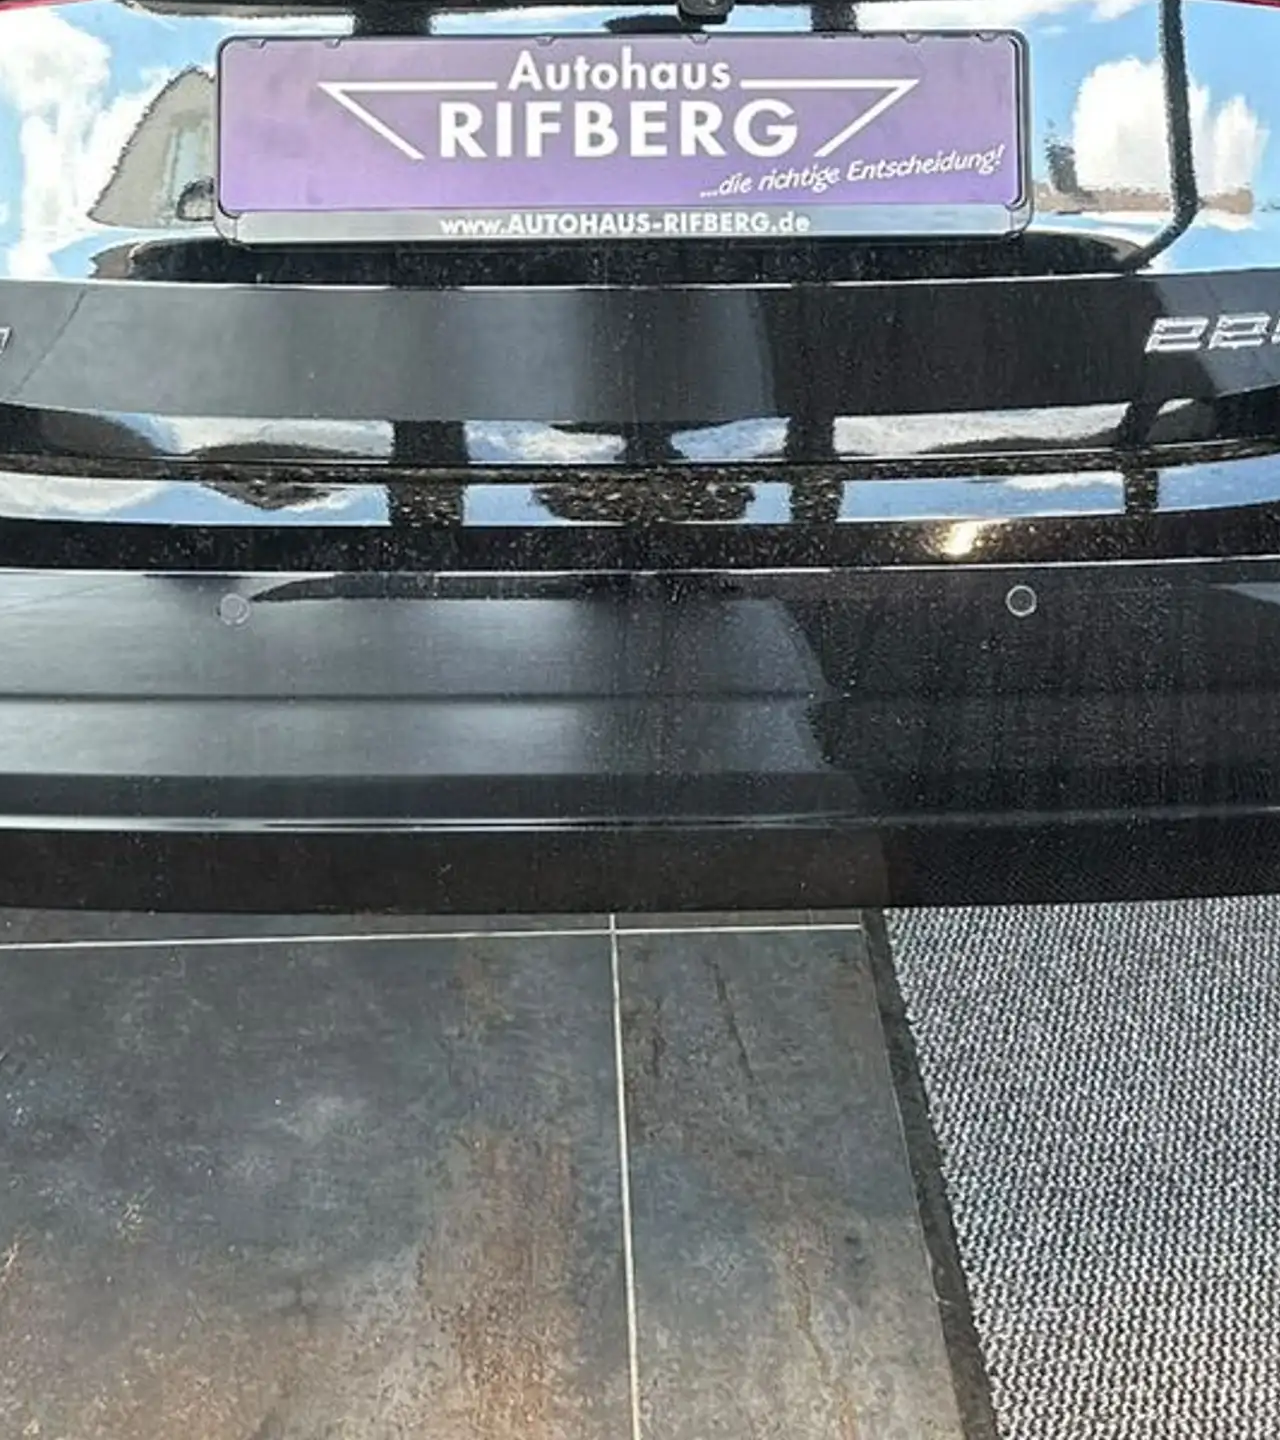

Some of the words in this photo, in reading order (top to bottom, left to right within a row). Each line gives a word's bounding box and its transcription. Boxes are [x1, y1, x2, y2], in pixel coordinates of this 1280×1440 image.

[508, 46, 732, 91] Autohaus
[438, 98, 799, 158] RIFBERG
[758, 165, 841, 192] richtige
[846, 145, 1006, 183] Entscheidung!
[440, 211, 811, 235] www.AUTOHAUS-RIFBERG.de
